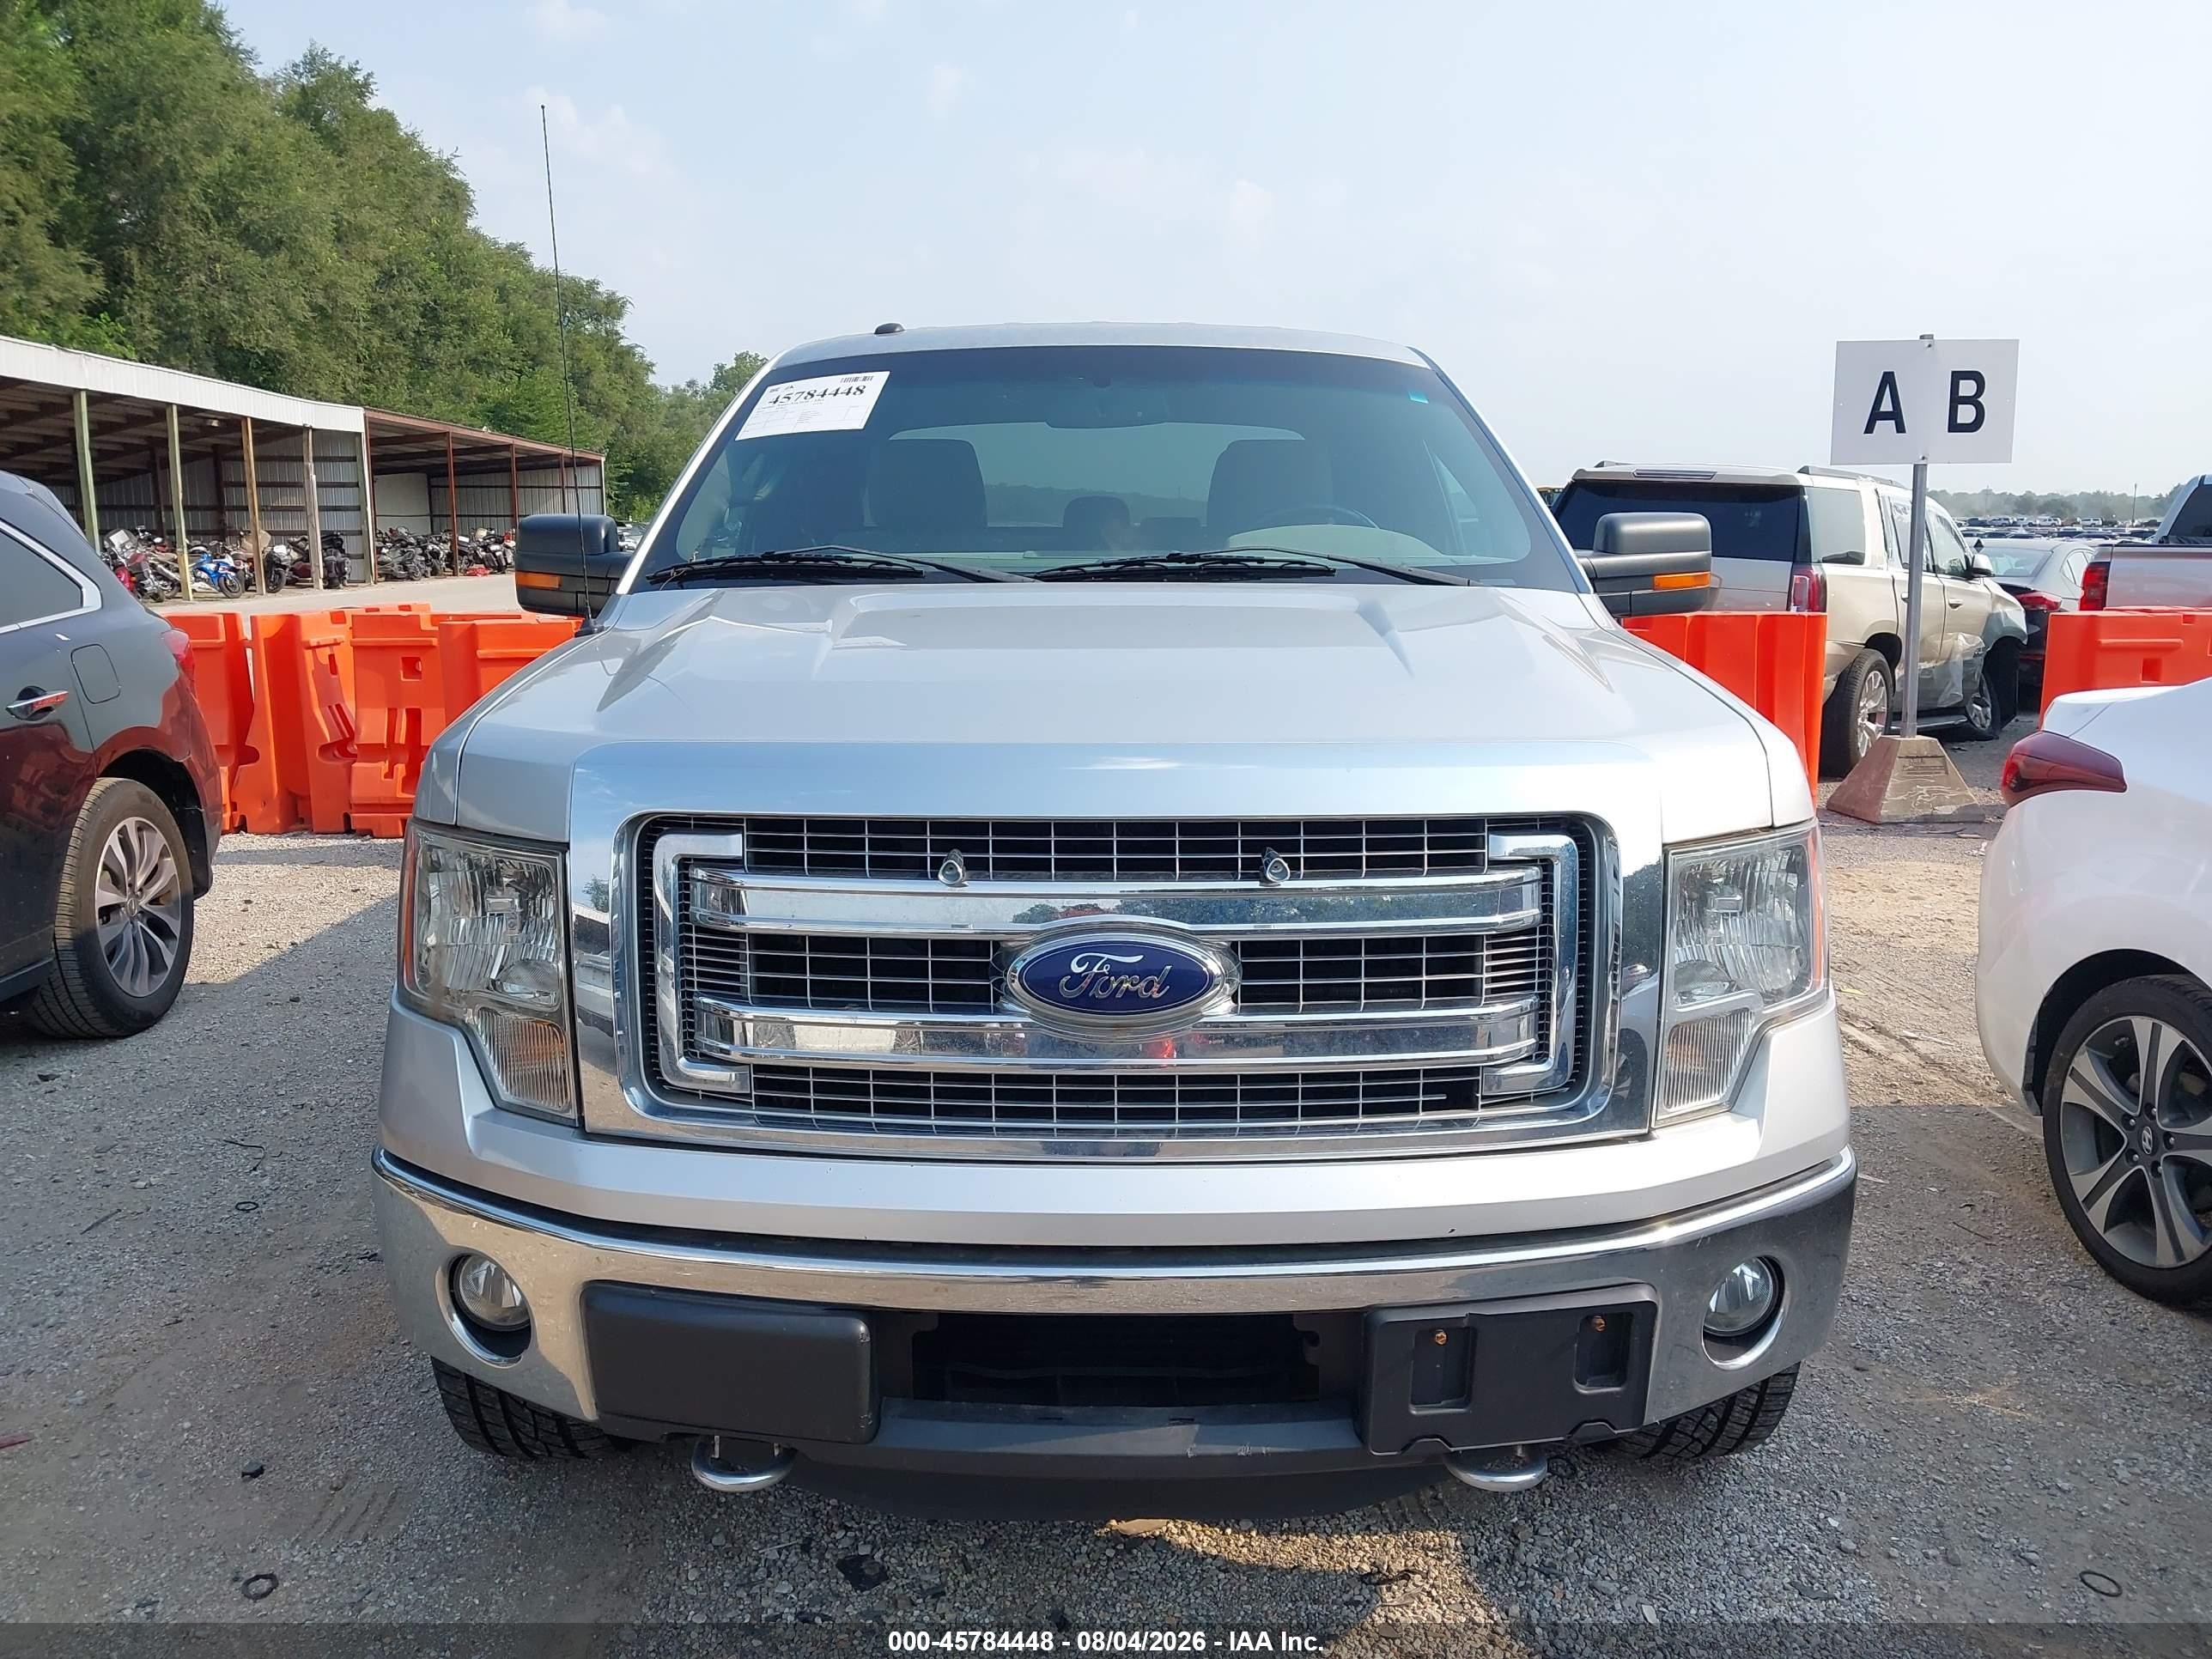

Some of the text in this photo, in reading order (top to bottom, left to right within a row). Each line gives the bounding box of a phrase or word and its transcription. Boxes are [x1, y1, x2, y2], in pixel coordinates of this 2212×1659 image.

[768, 385, 866, 404] 45784448
[1863, 370, 1985, 434] A B
[1059, 952, 1173, 999] Ford
